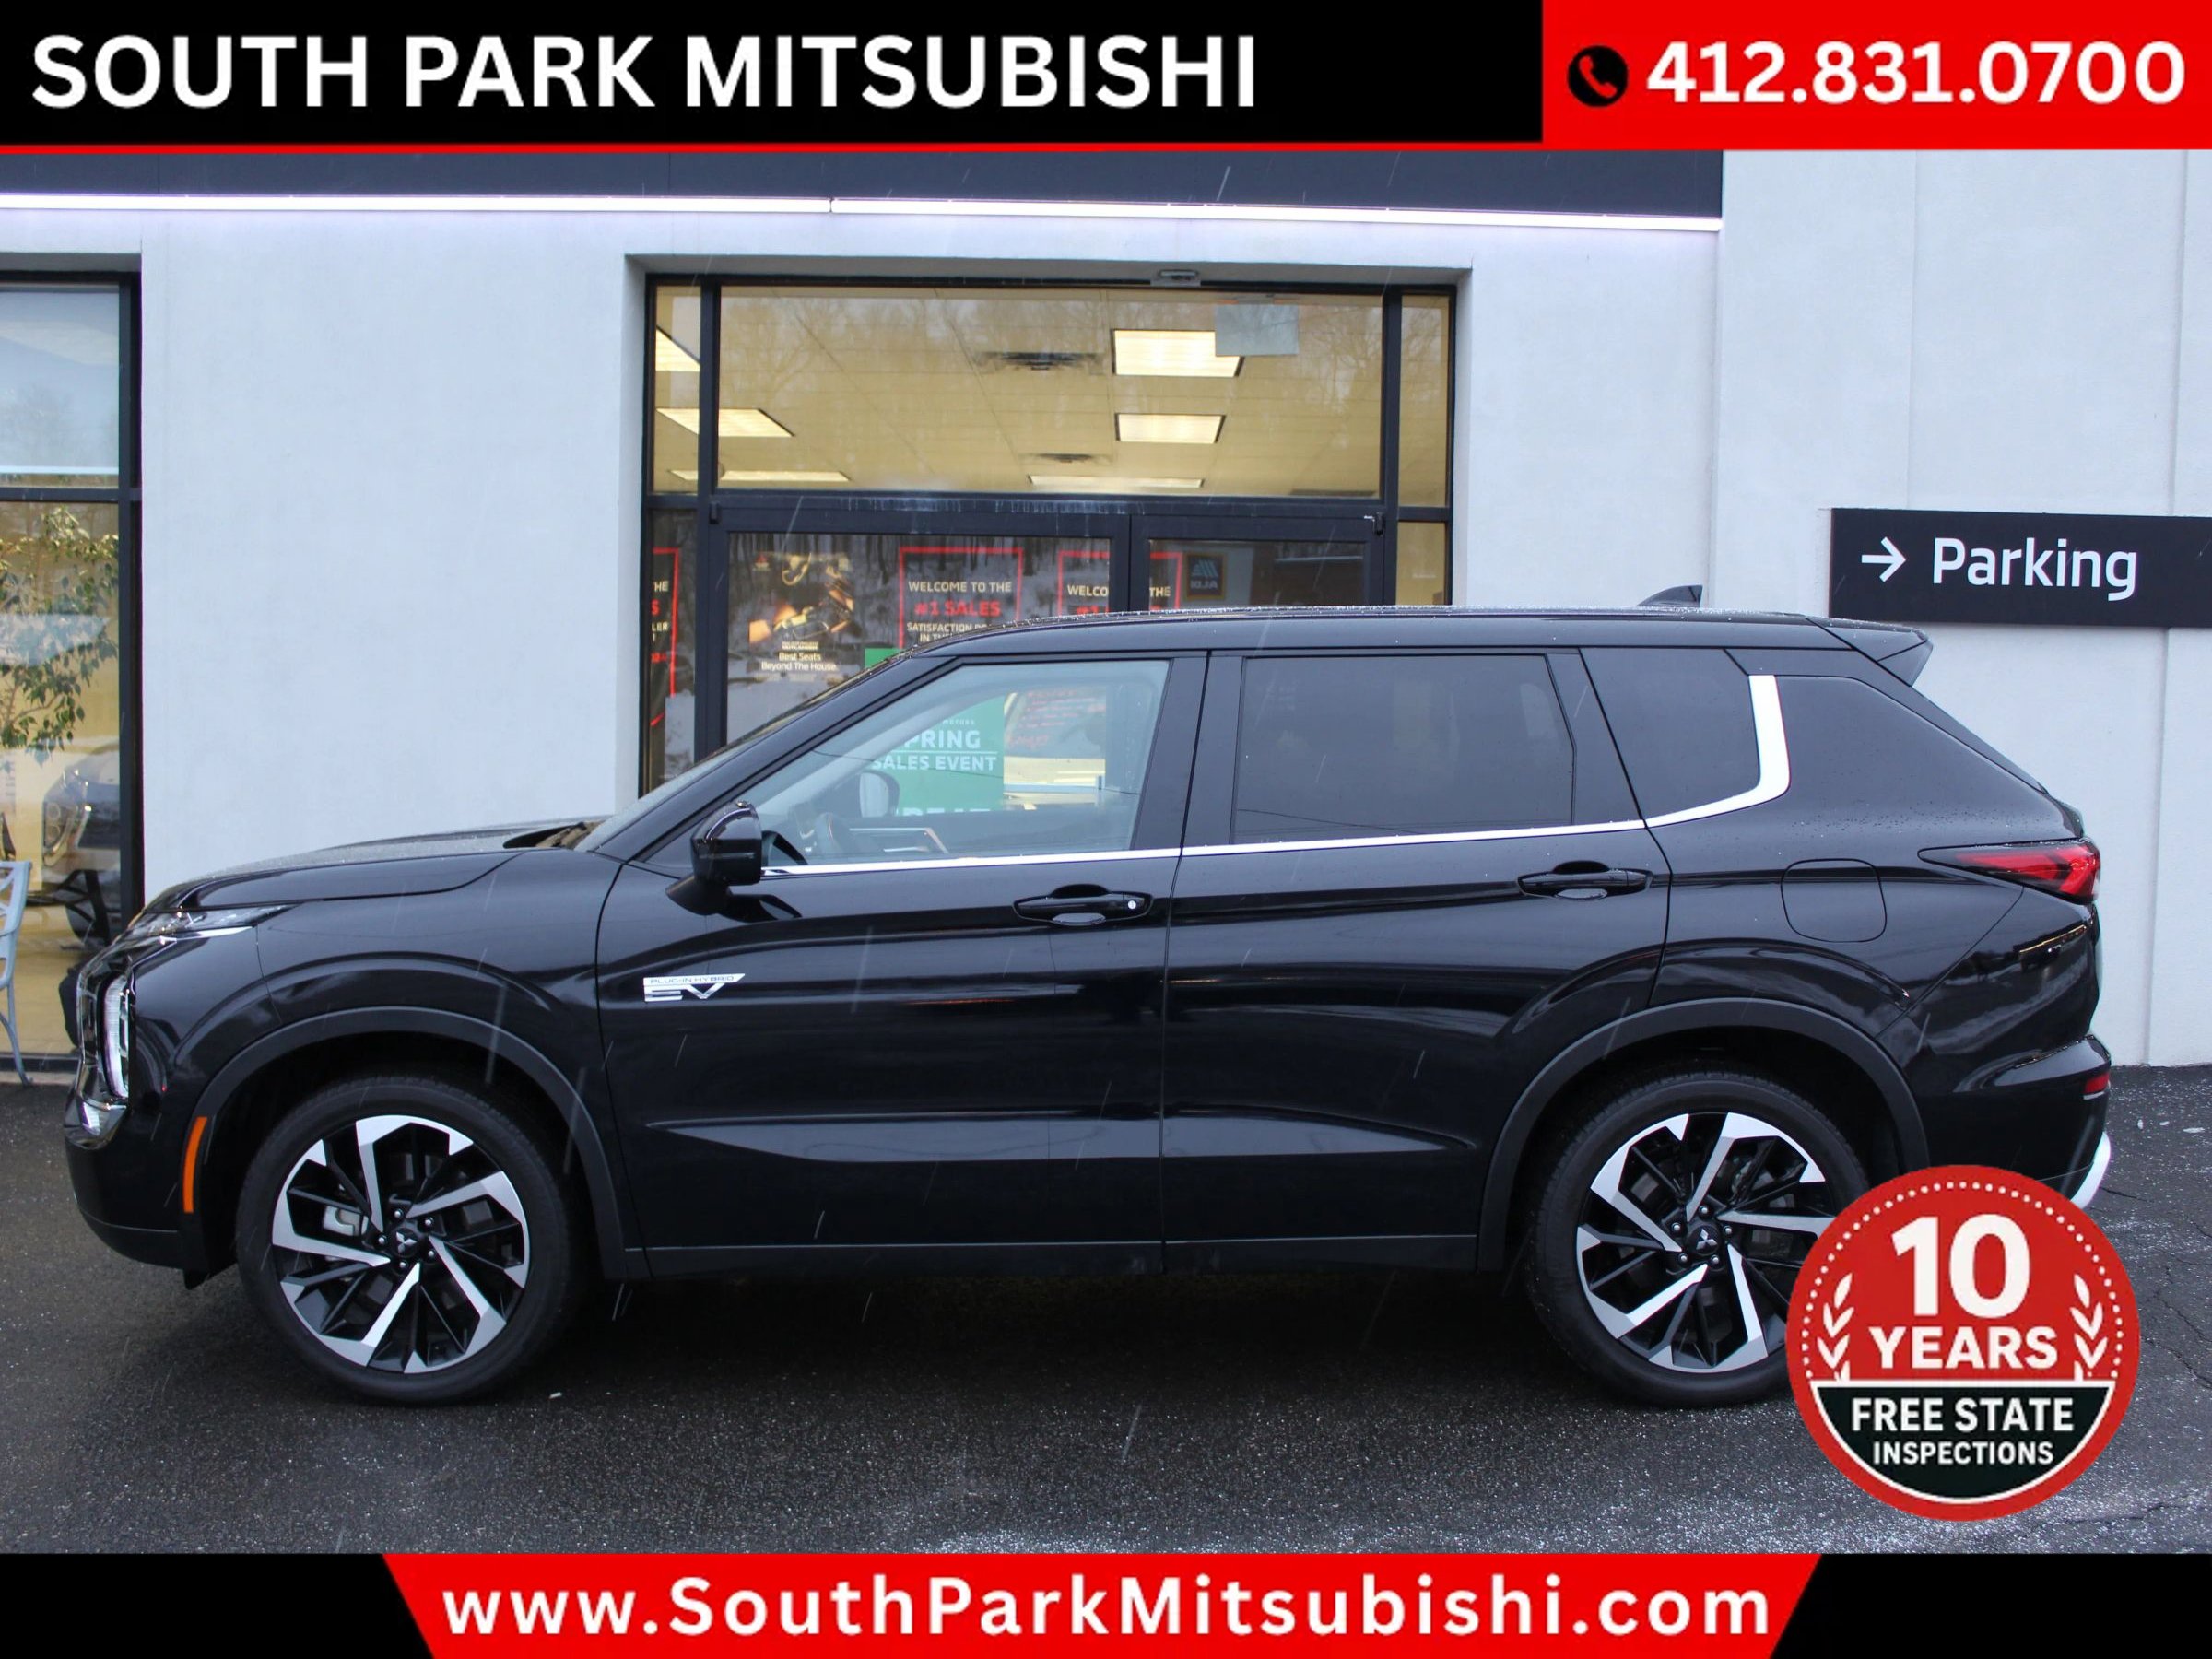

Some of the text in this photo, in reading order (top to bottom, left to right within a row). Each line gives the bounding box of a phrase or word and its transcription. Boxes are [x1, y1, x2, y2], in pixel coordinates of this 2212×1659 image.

[1933, 536, 2137, 602] Parking
[653, 581, 669, 592] HE
[908, 582, 1012, 592] WELCOME TO THE
[914, 600, 1001, 617] #1 SALES
[907, 622, 972, 632] SATISFACTION
[920, 633, 930, 642] IN
[761, 661, 793, 671] Beyond
[794, 662, 809, 671] The
[871, 755, 997, 771] SALES EVENT
